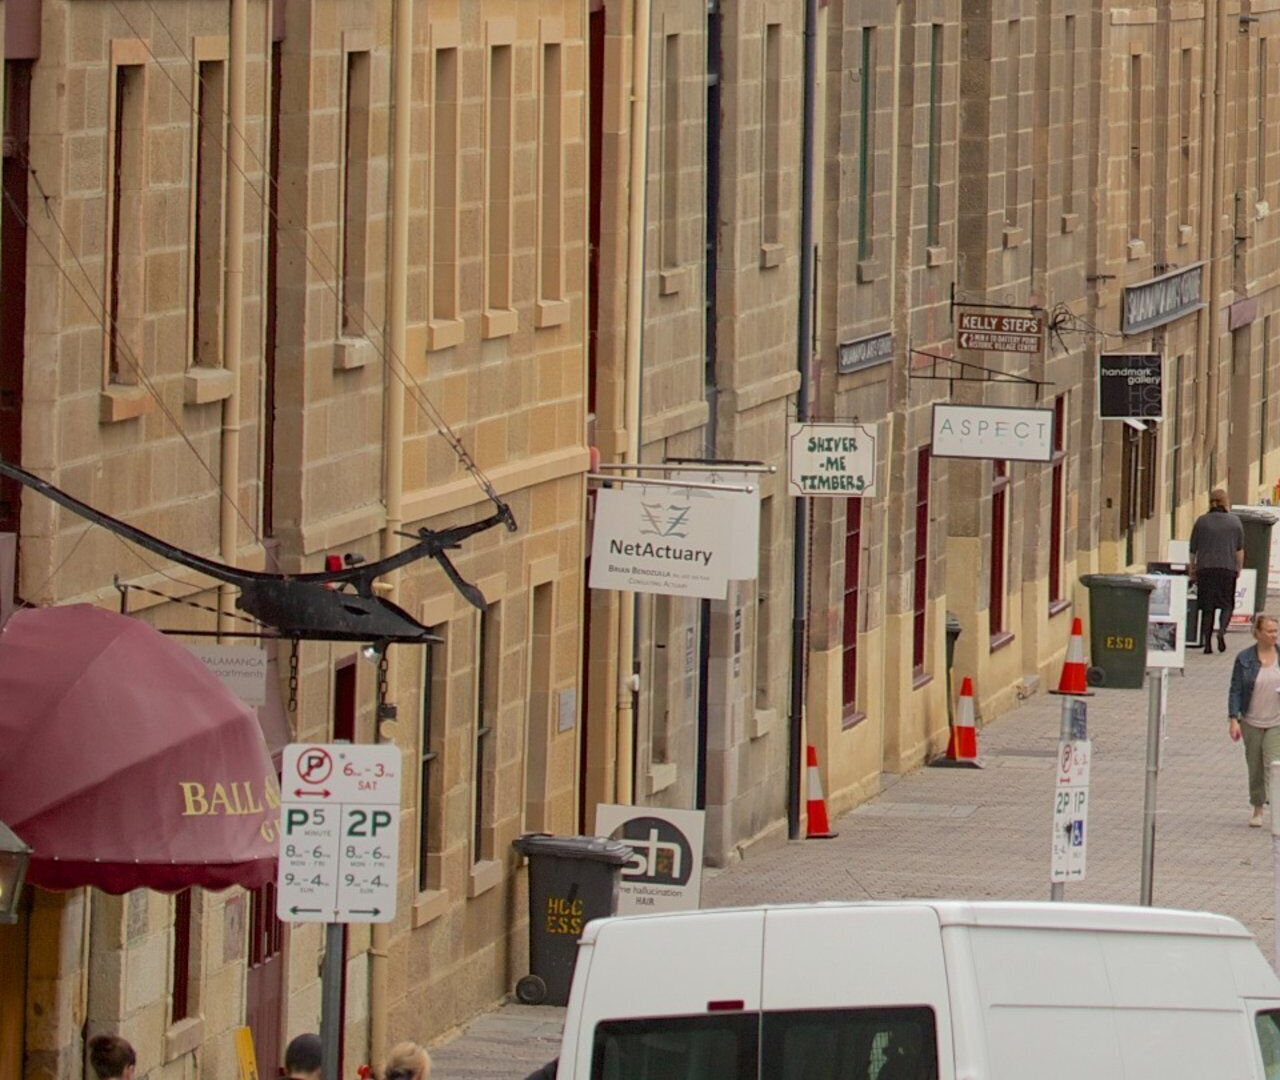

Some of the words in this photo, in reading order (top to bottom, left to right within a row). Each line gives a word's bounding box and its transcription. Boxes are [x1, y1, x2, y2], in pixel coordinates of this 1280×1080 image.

[962, 316, 998, 330] KELLY
[1002, 318, 1038, 332] STEPS
[1102, 368, 1151, 376] handmark
[1128, 376, 1160, 386] gallery
[940, 419, 1046, 438] ASPECT
[808, 437, 858, 452] SHIVER
[801, 475, 864, 490] TIMBERS
[610, 539, 712, 566] NetActuary
[201, 656, 263, 666] SALAMANCA
[216, 670, 263, 678] partments
[358, 781, 378, 790] SAT
[179, 781, 264, 816] BALL
[1056, 793, 1070, 814] 2P
[347, 810, 392, 836] 2P
[633, 886, 682, 897] hallucination
[548, 898, 584, 916] HCC
[636, 897, 654, 905] HAIR
